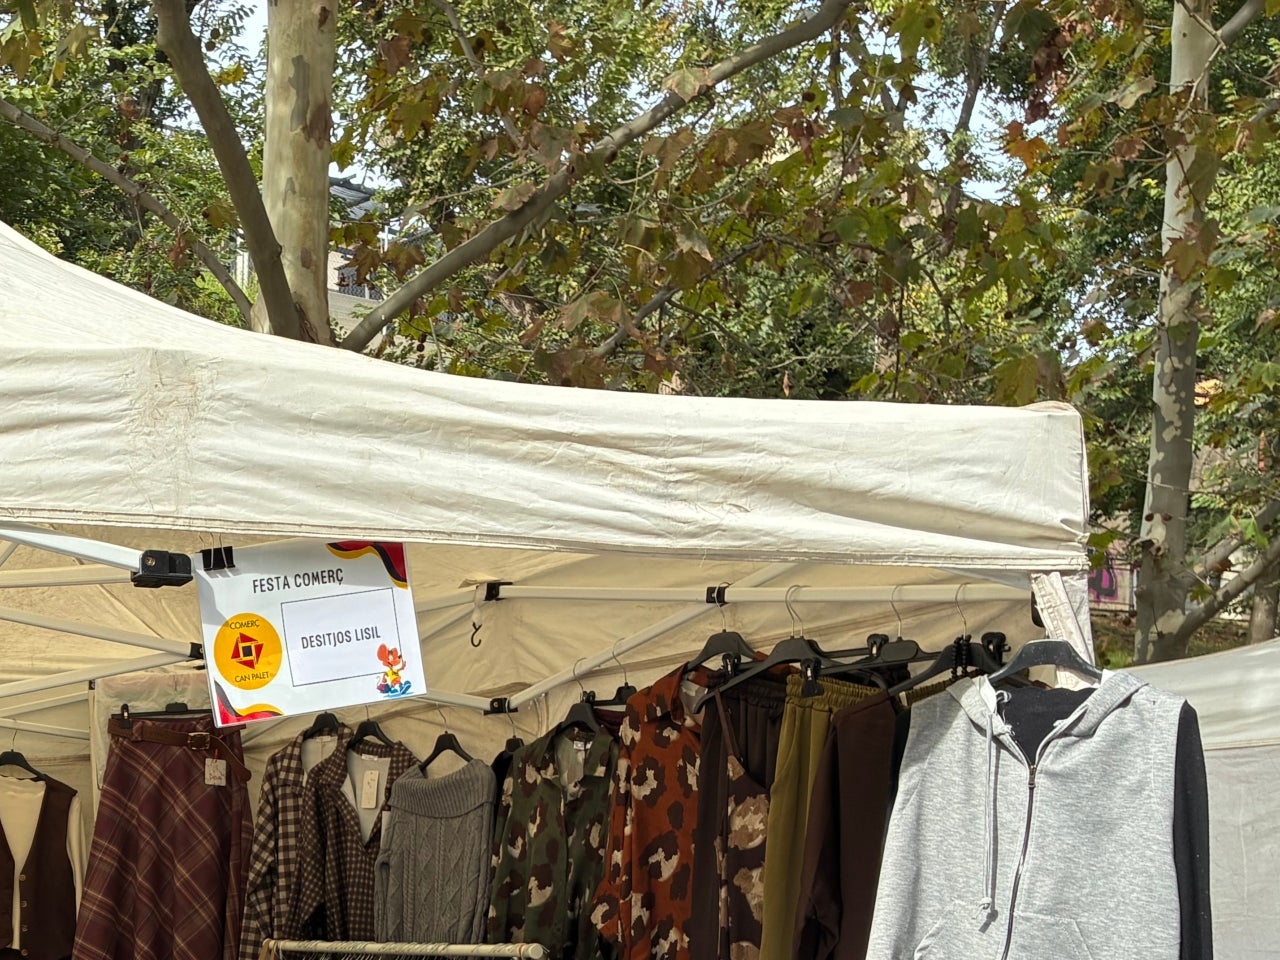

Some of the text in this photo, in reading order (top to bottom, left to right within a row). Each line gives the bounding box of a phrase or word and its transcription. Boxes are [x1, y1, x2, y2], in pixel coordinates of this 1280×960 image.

[252, 568, 344, 593] FESTA COMERÇ
[229, 619, 261, 629] COMERÇ
[301, 626, 381, 649] DESITJOS LISIL
[234, 671, 270, 683] CAN PALET
